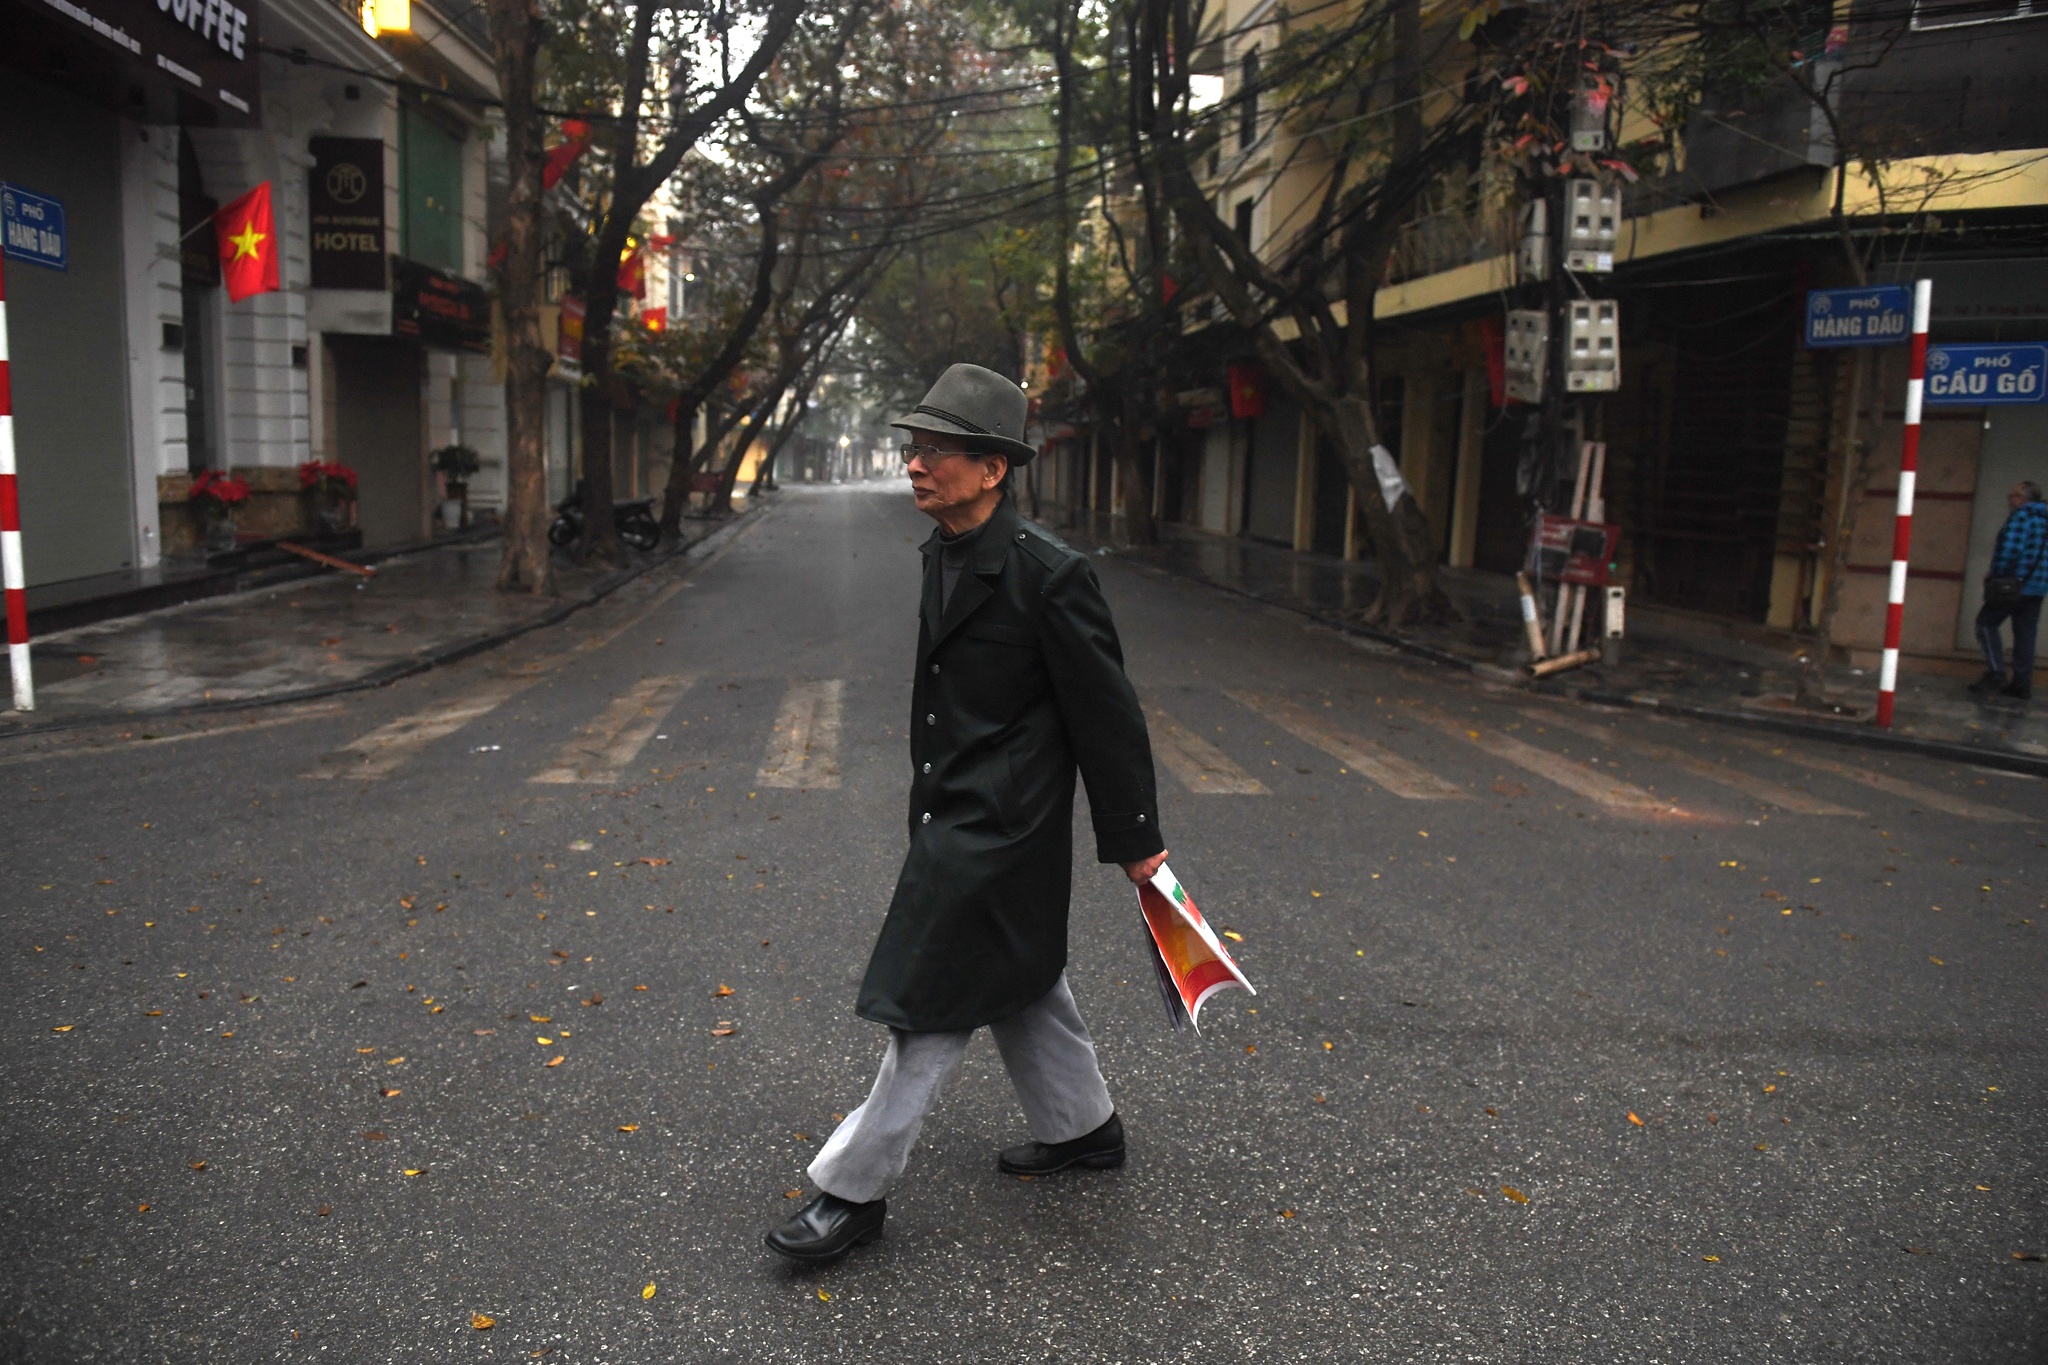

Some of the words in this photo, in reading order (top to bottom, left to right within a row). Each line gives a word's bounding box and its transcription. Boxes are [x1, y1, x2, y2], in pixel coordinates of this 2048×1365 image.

[157, 0, 247, 61] FFEE
[315, 232, 379, 252] HOTEL
[1848, 293, 1880, 310] PHỐ
[1812, 313, 1862, 338] HÀNG
[1974, 352, 2012, 368] PHỐ
[1997, 364, 2041, 393] GỖ
